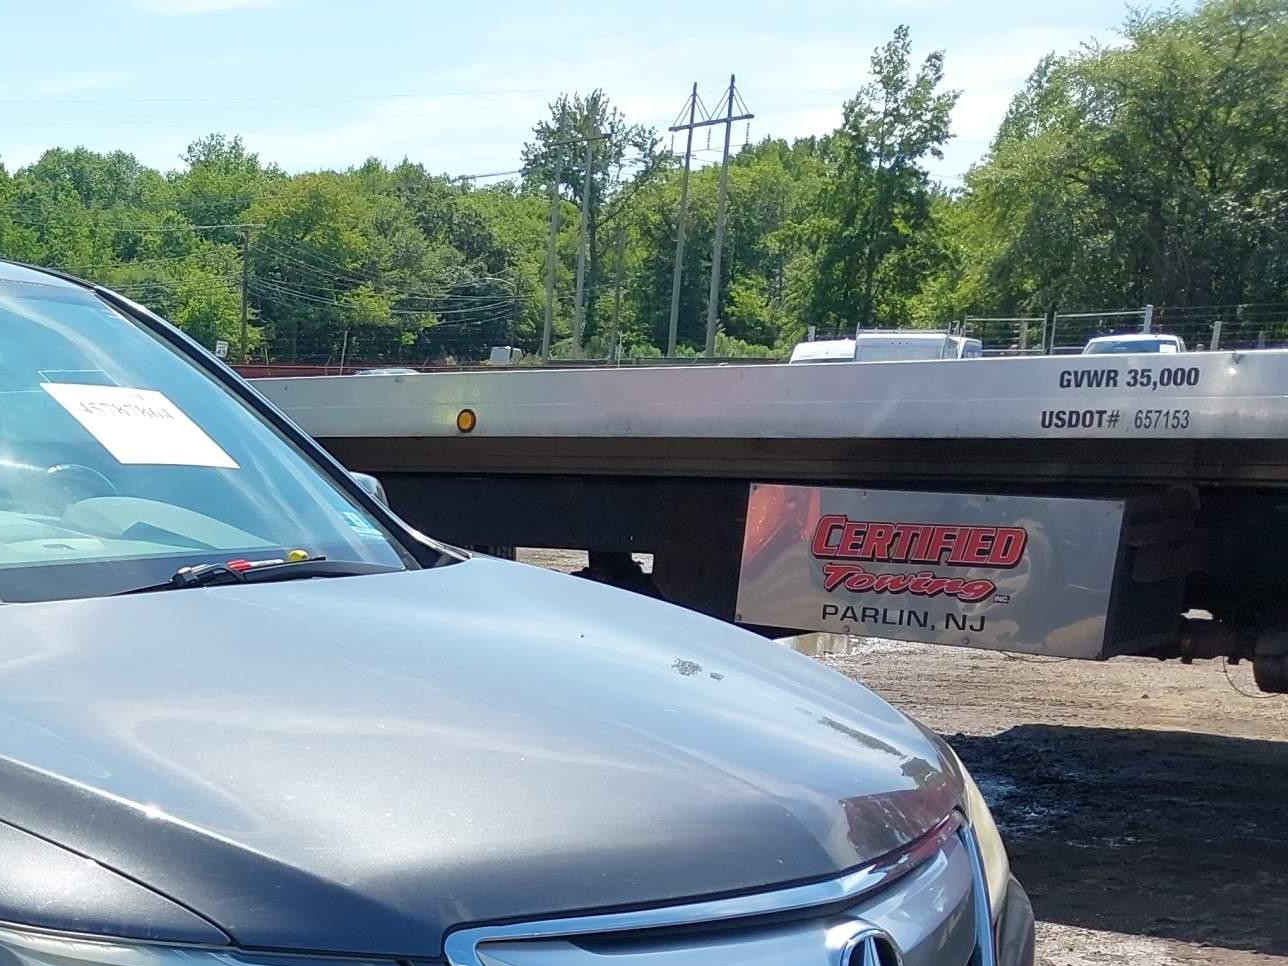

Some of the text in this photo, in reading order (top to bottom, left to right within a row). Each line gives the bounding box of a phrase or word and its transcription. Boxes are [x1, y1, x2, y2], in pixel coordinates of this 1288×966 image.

[1059, 367, 1200, 391] GVWR 35,000
[1041, 409, 1190, 430] USDOT# 657153
[811, 514, 1028, 569] CERTIFIED
[822, 562, 997, 604] Towing
[821, 604, 985, 632] PARLIN, NJ
